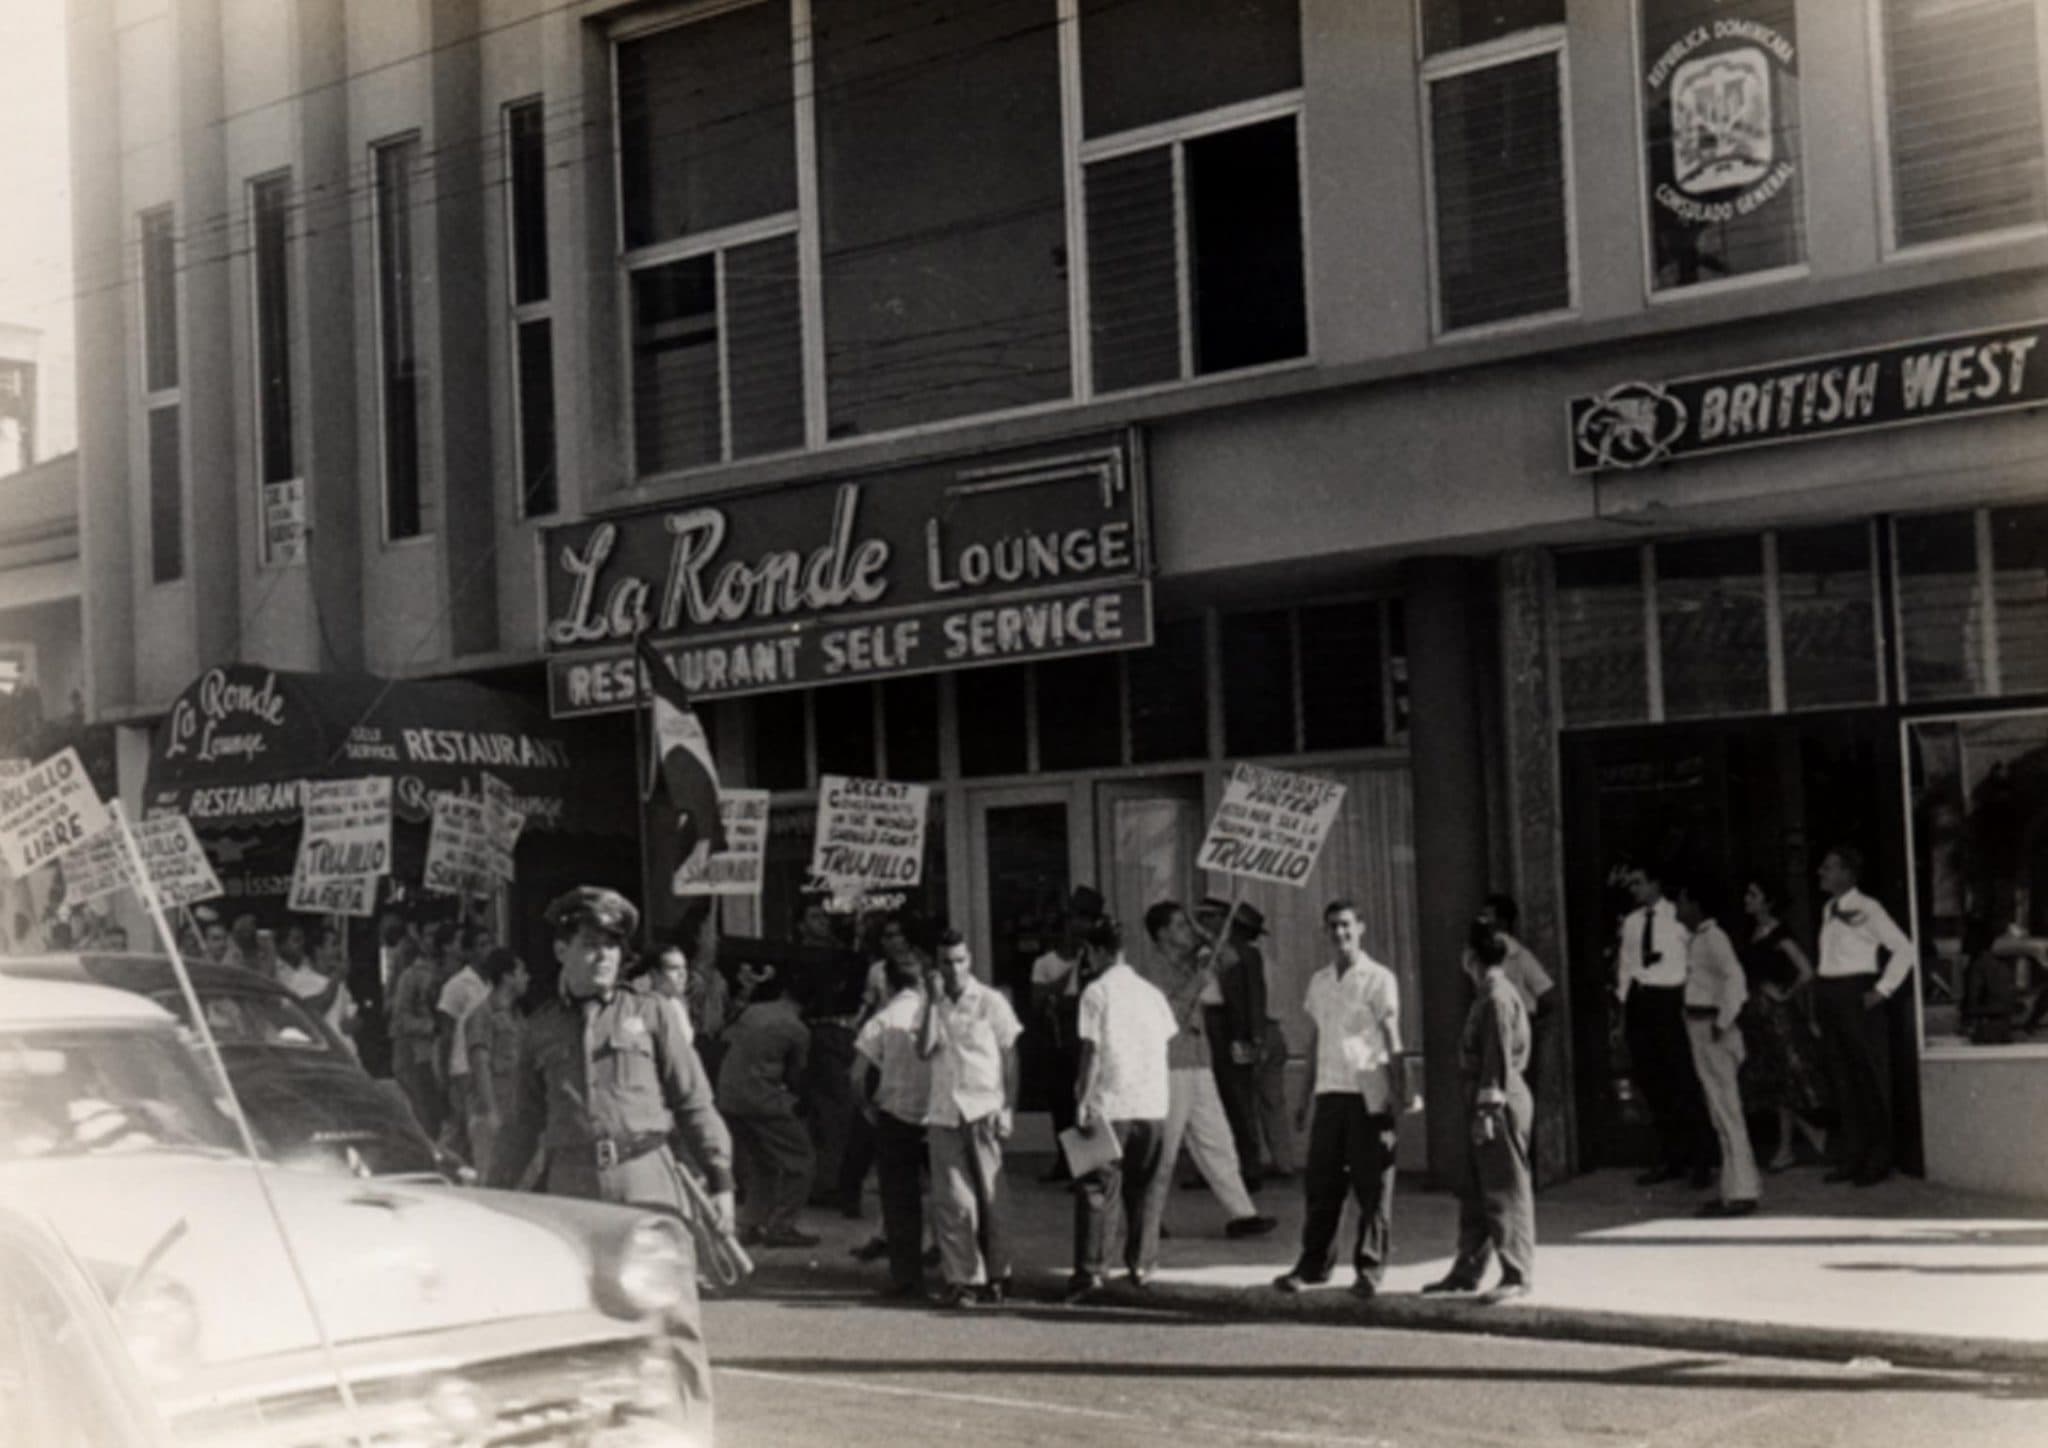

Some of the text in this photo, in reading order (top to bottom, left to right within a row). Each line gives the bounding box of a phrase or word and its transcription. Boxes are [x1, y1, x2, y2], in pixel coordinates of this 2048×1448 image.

[1714, 19, 1794, 64] DOMINICANA
[1655, 162, 1794, 222] CONSULADO GENERAL
[1701, 336, 2038, 440] BRITISH WEST
[548, 483, 890, 644] La Ronde
[568, 594, 1124, 705] RESURANT SELF SERVICE
[200, 668, 285, 725] Ronde
[200, 720, 267, 761] Lounge
[0, 756, 74, 815] RUJILLO
[842, 776, 910, 798] DECENT
[22, 811, 85, 867] LIBRE
[821, 845, 917, 881] TRUJILLO
[1204, 835, 1312, 880] TRUJILLO
